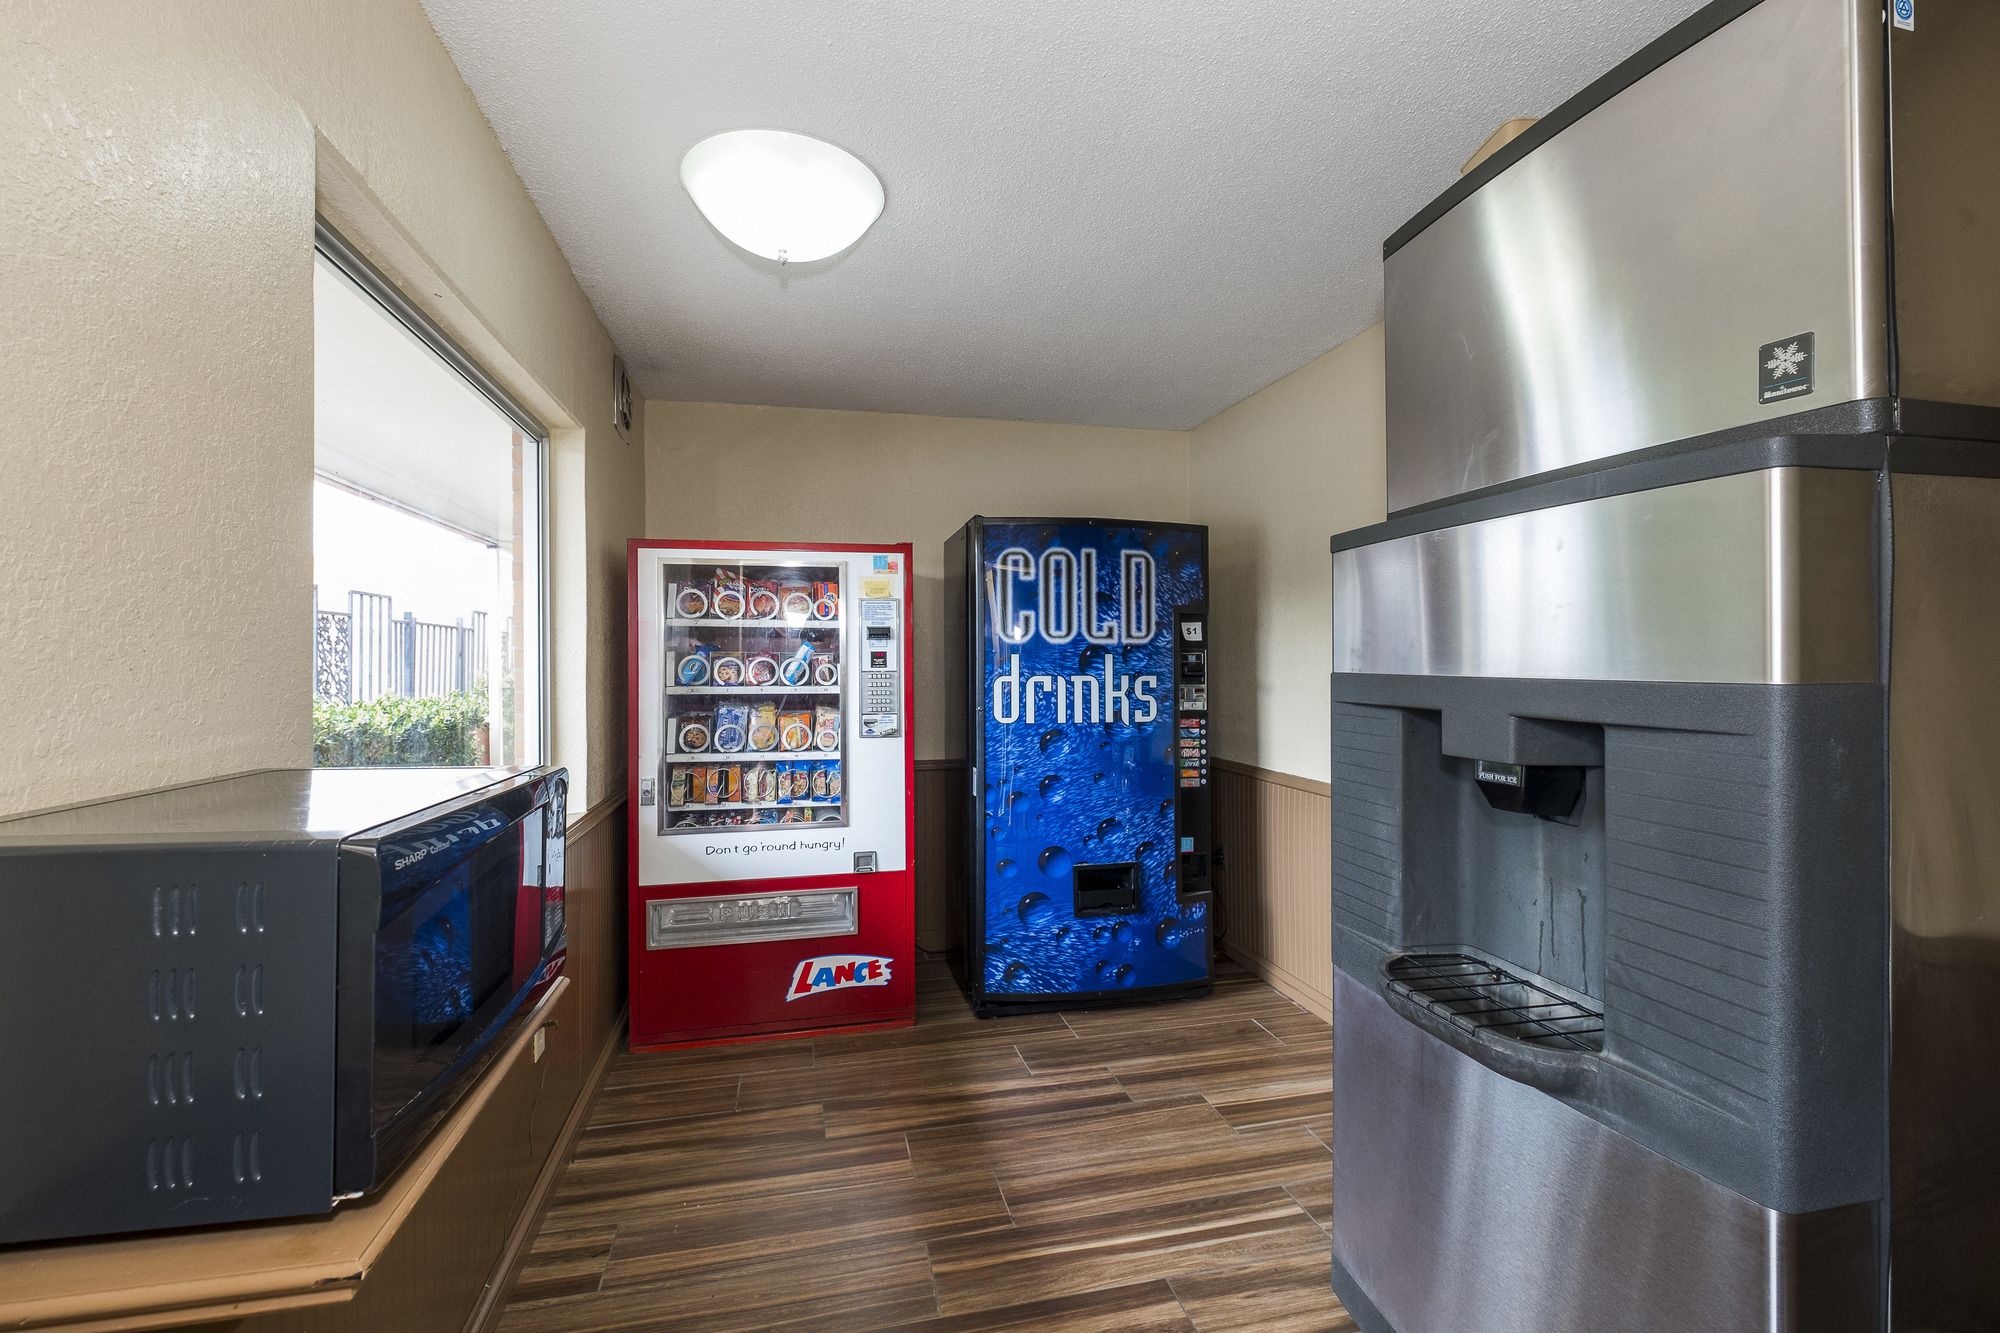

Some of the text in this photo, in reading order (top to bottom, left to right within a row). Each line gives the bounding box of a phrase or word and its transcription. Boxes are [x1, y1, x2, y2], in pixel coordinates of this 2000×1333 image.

[996, 547, 1157, 645] COLD
[1185, 627, 1198, 637] $1
[993, 653, 1158, 727] drinks
[1479, 772, 1518, 784] PUSH FOR ICE
[705, 845, 739, 856] Dont
[742, 845, 758, 856] go
[800, 837, 845, 852] hungry!
[395, 848, 427, 870] SHARP
[794, 959, 883, 995] LANCE
